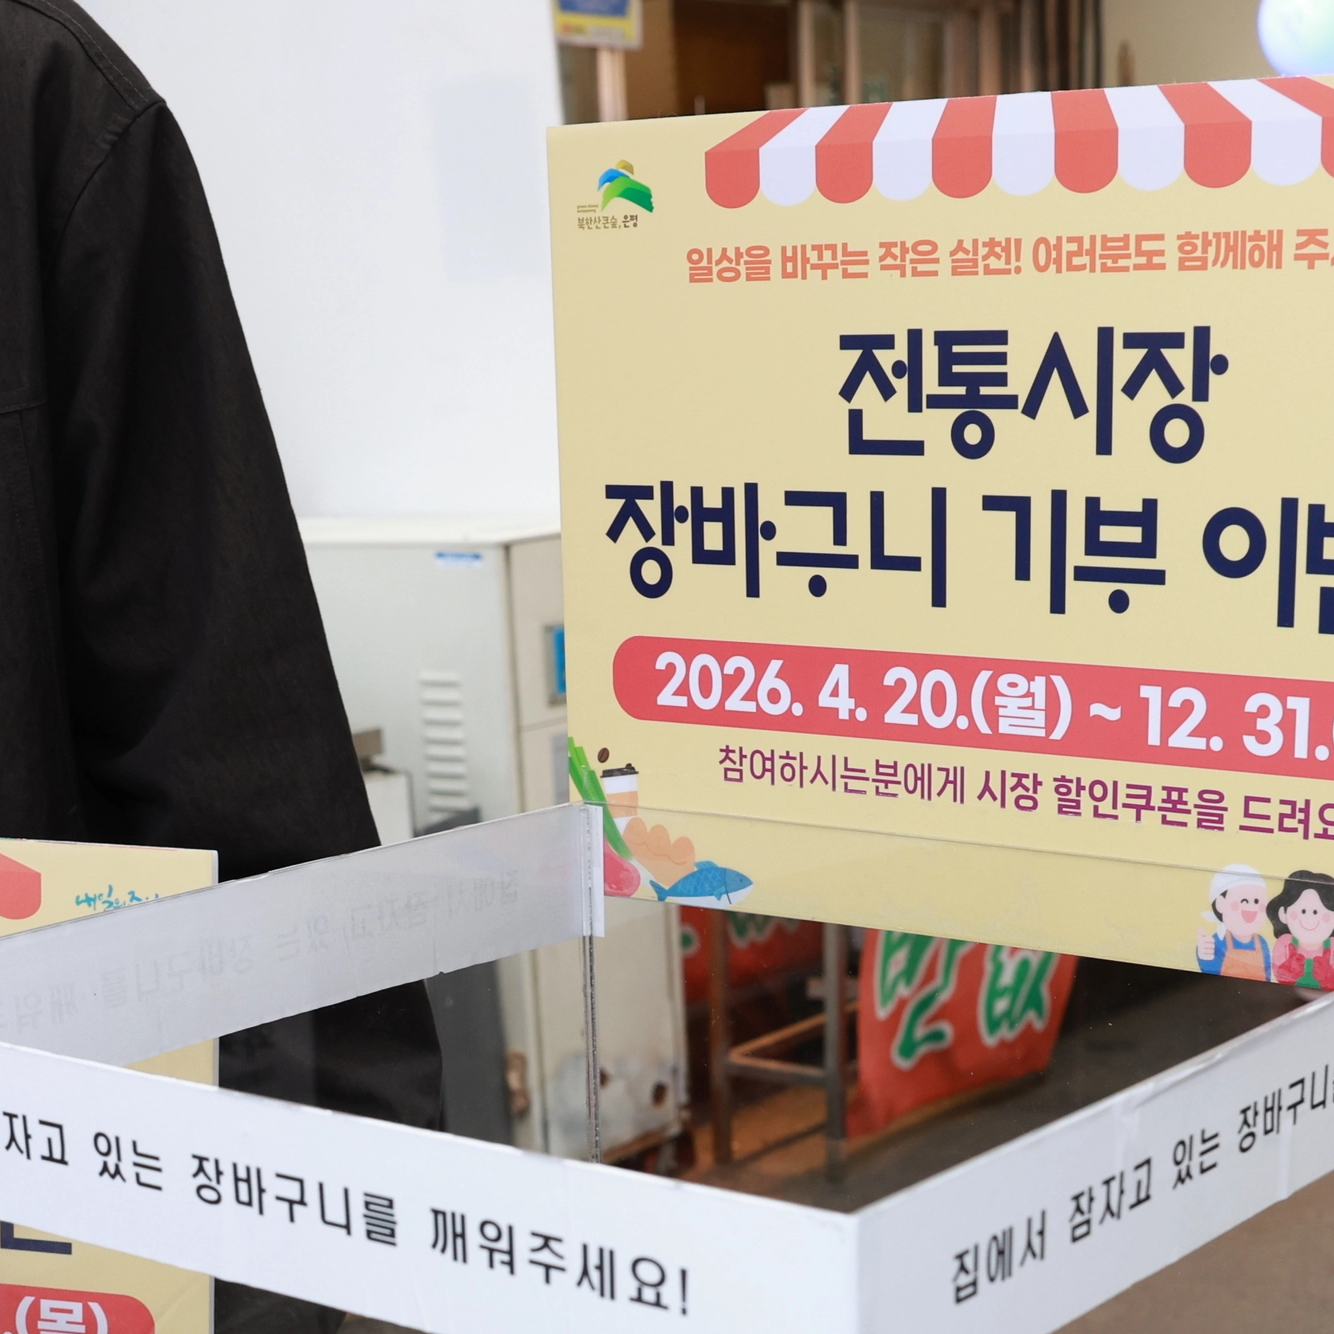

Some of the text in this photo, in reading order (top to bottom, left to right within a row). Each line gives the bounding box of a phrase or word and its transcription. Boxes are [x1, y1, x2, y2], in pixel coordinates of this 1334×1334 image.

[622, 214, 639, 228] 은평
[686, 244, 772, 283] 일상을
[780, 242, 869, 281] 바꾸는
[878, 240, 940, 278] 작은
[949, 237, 1023, 276] 실천!
[1032, 233, 1166, 274] 여러분도
[1176, 230, 1284, 272] 함께해
[838, 325, 1229, 464] 전통시장
[605, 480, 947, 608] 장바구니
[982, 489, 1166, 614] 기부
[654, 651, 804, 717] 2026.
[818, 663, 868, 722] 4.
[883, 666, 1073, 741] 20.(월)
[1139, 684, 1224, 752] 12.
[718, 744, 966, 804] 참여하시는분에게
[976, 770, 1043, 813] 시장
[1052, 774, 1229, 832] 할인쿠폰을
[93, 1132, 163, 1191] 있는
[191, 1154, 398, 1247] 장바구니를
[431, 1208, 689, 1316] 깨워주세요!
[952, 1210, 1047, 1305] 집에서
[1068, 1157, 1152, 1244] 잠자고
[1172, 1127, 1221, 1191] 있는
